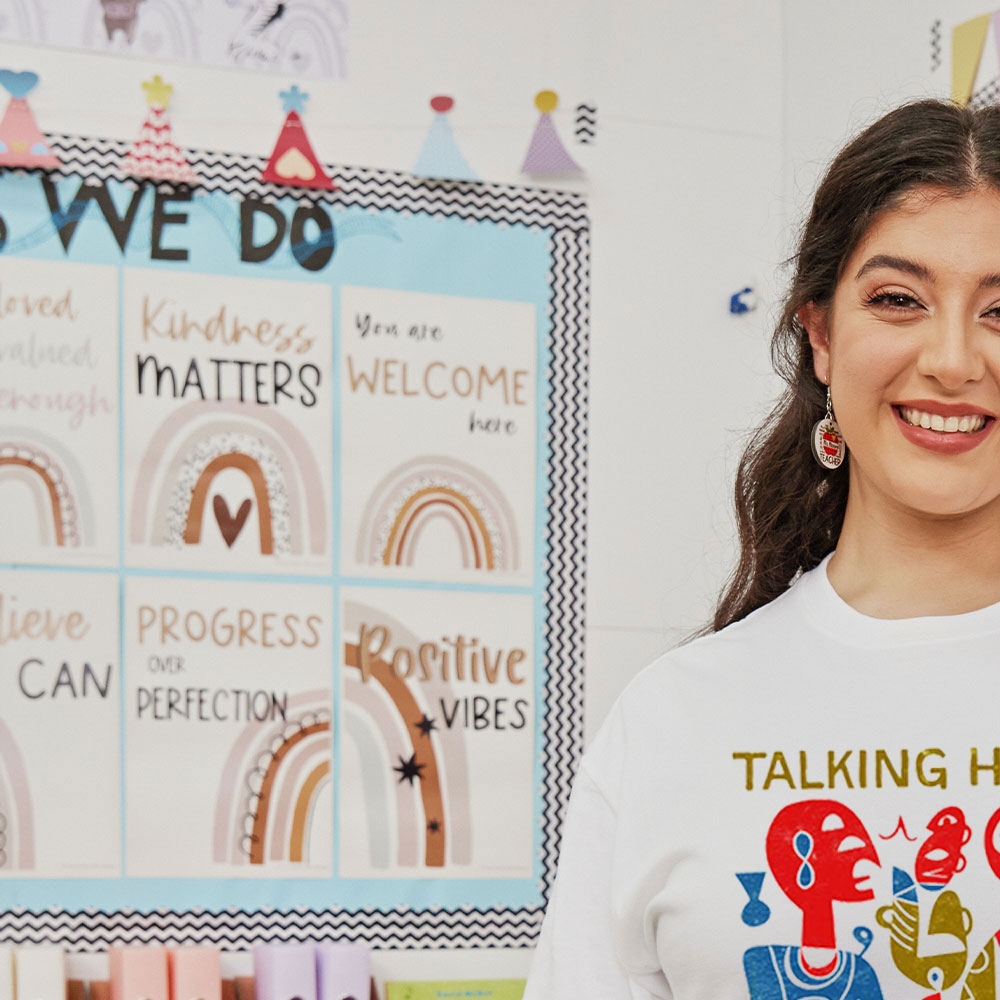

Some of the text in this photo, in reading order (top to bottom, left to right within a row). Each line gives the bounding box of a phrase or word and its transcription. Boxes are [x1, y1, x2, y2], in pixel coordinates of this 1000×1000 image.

[41, 172, 193, 262] WE
[240, 195, 337, 272] DO
[142, 296, 317, 354] Kindness
[354, 313, 443, 342] You are
[347, 355, 530, 406] WELCOME
[468, 410, 518, 435] here
[137, 605, 324, 649] PROGRESS
[148, 654, 187, 674] OVER
[358, 622, 528, 685] Positive
[18, 657, 113, 699] CAN
[136, 687, 289, 722] PERFECTION
[439, 696, 531, 731] VIBES
[733, 749, 948, 791] TALKING
